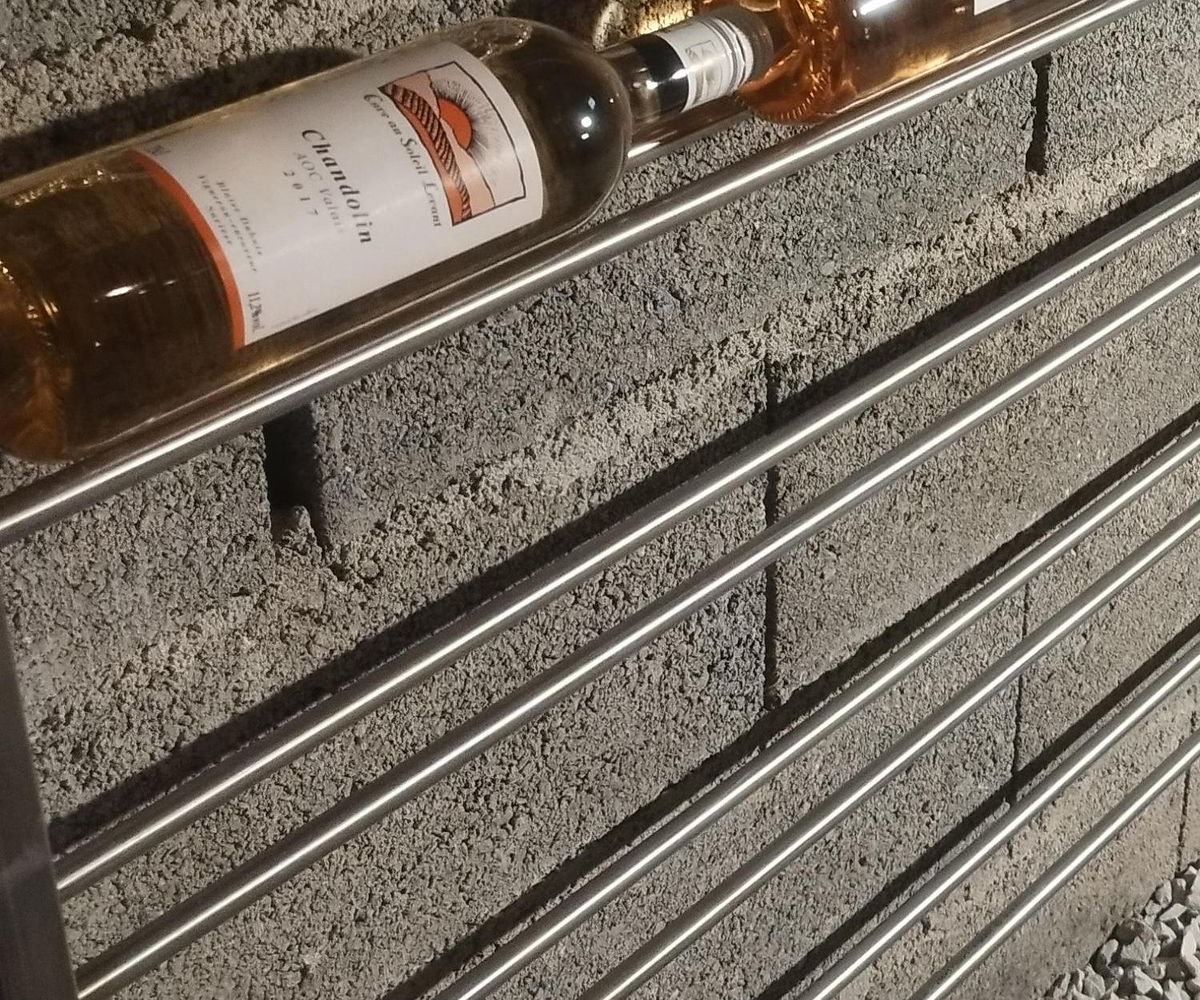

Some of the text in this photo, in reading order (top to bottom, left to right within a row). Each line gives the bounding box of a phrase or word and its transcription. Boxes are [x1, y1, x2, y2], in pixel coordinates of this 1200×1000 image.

[282, 169, 319, 216] 2017
[292, 152, 323, 181] AOC
[301, 129, 373, 243] Chandolin
[400, 137, 429, 175] Soleil
[423, 180, 441, 227] Levant
